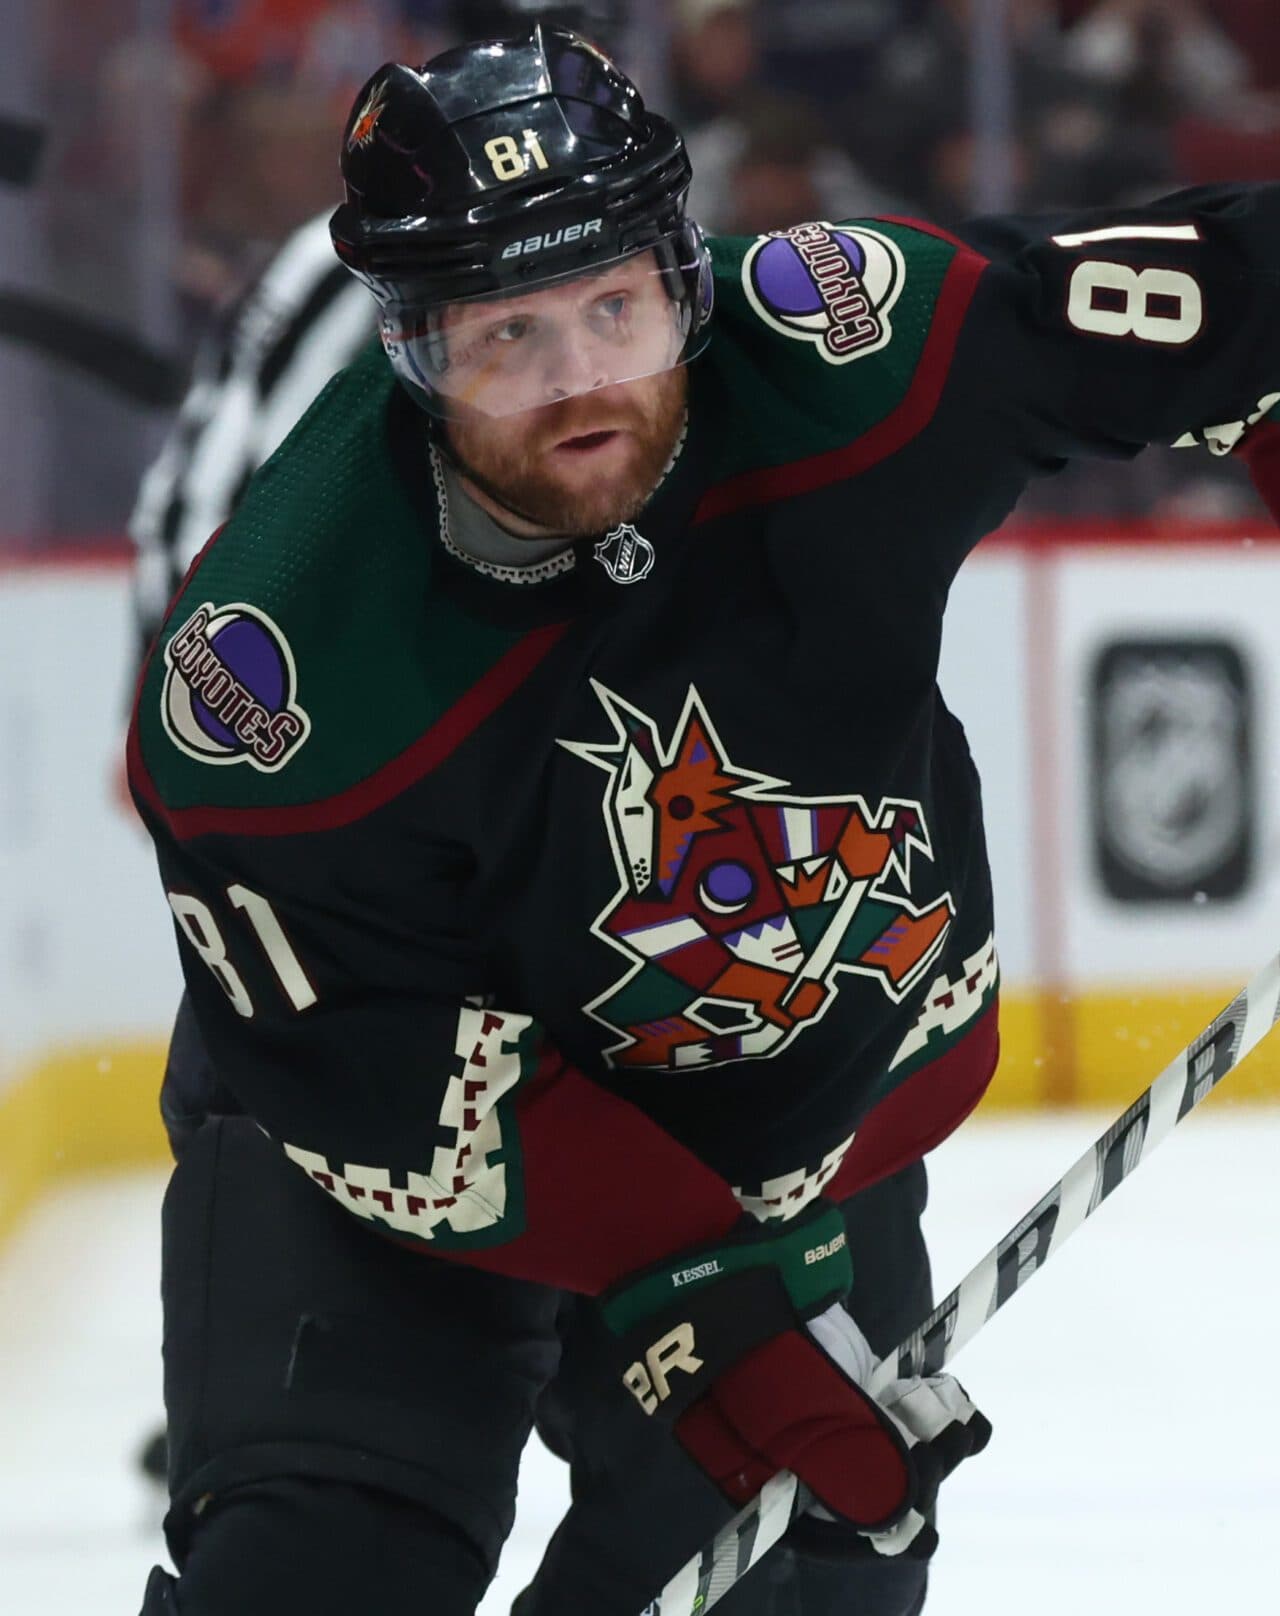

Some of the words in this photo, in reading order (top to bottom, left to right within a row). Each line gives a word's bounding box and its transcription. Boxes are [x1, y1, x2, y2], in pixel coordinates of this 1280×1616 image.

[484, 127, 549, 182] 81
[500, 217, 603, 261] BAUER
[768, 221, 880, 353] COYOTES
[1051, 224, 1202, 344] 81
[172, 610, 300, 763] COYOTES
[167, 883, 318, 1018] 81
[671, 1260, 724, 1288] KESSEL
[803, 1231, 846, 1266] BAUER
